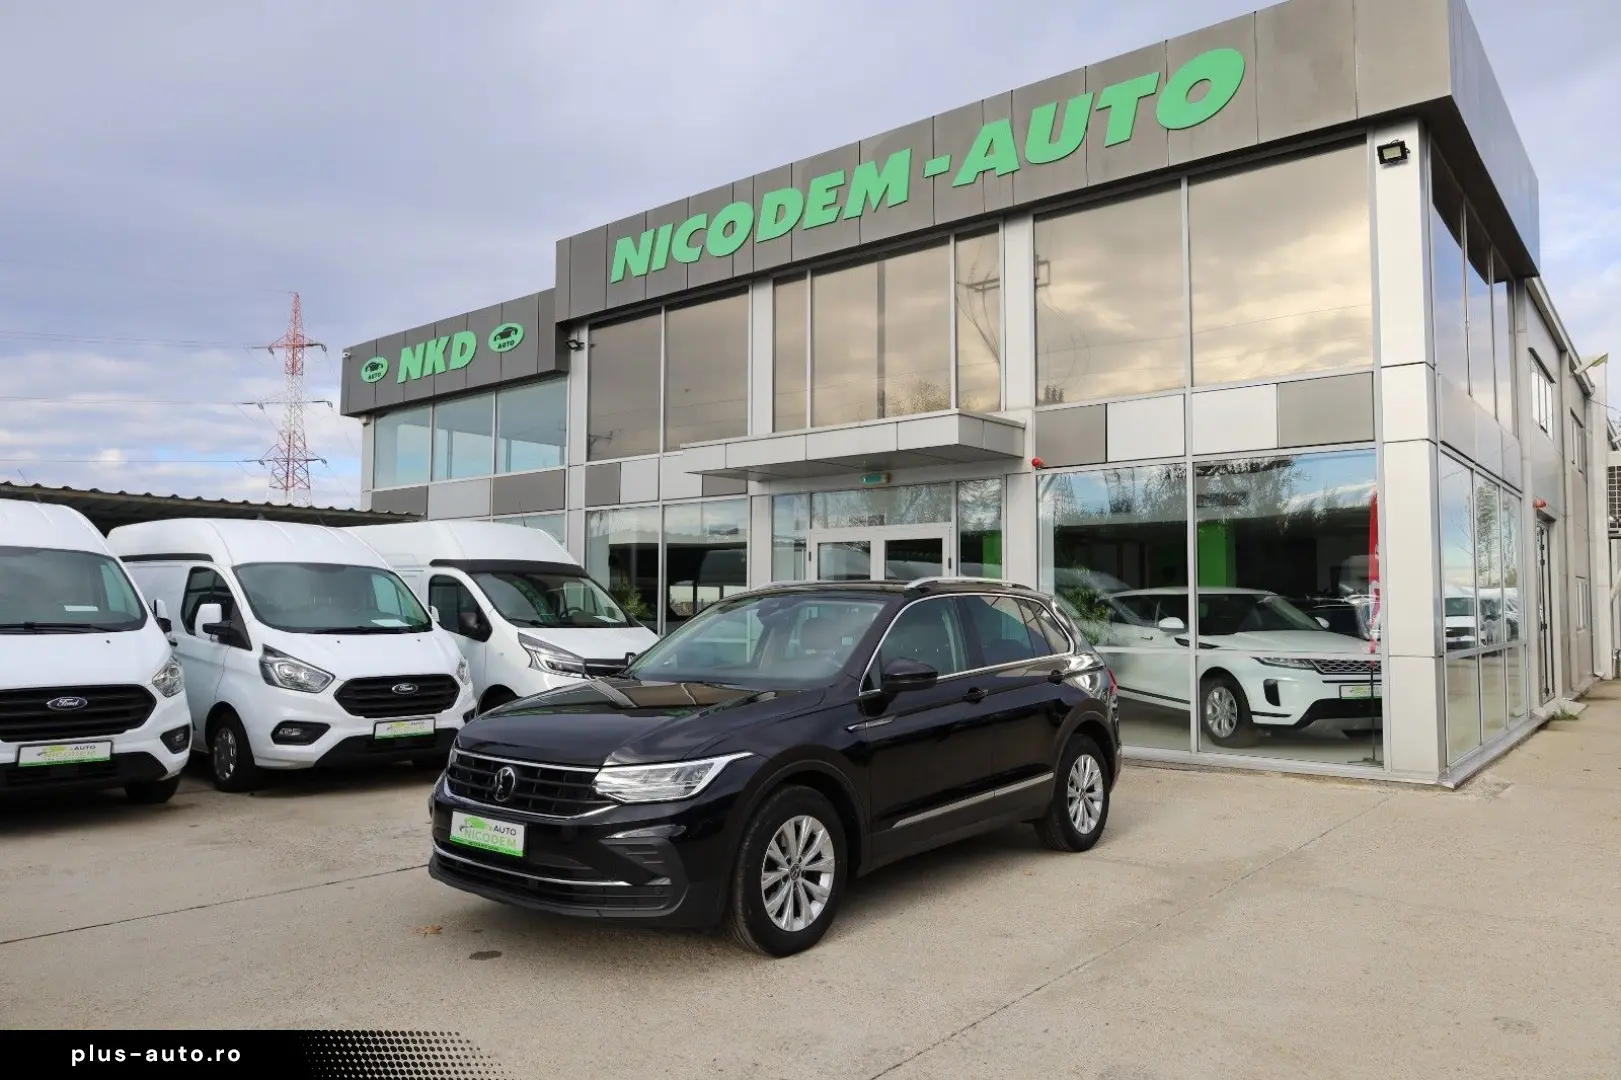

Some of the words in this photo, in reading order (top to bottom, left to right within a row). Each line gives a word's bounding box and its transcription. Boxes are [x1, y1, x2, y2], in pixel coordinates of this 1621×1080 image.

[497, 339, 515, 350] AUTO
[397, 330, 477, 384] NKD
[464, 828, 517, 849] NICODEM
[493, 825, 517, 837] AUTO
